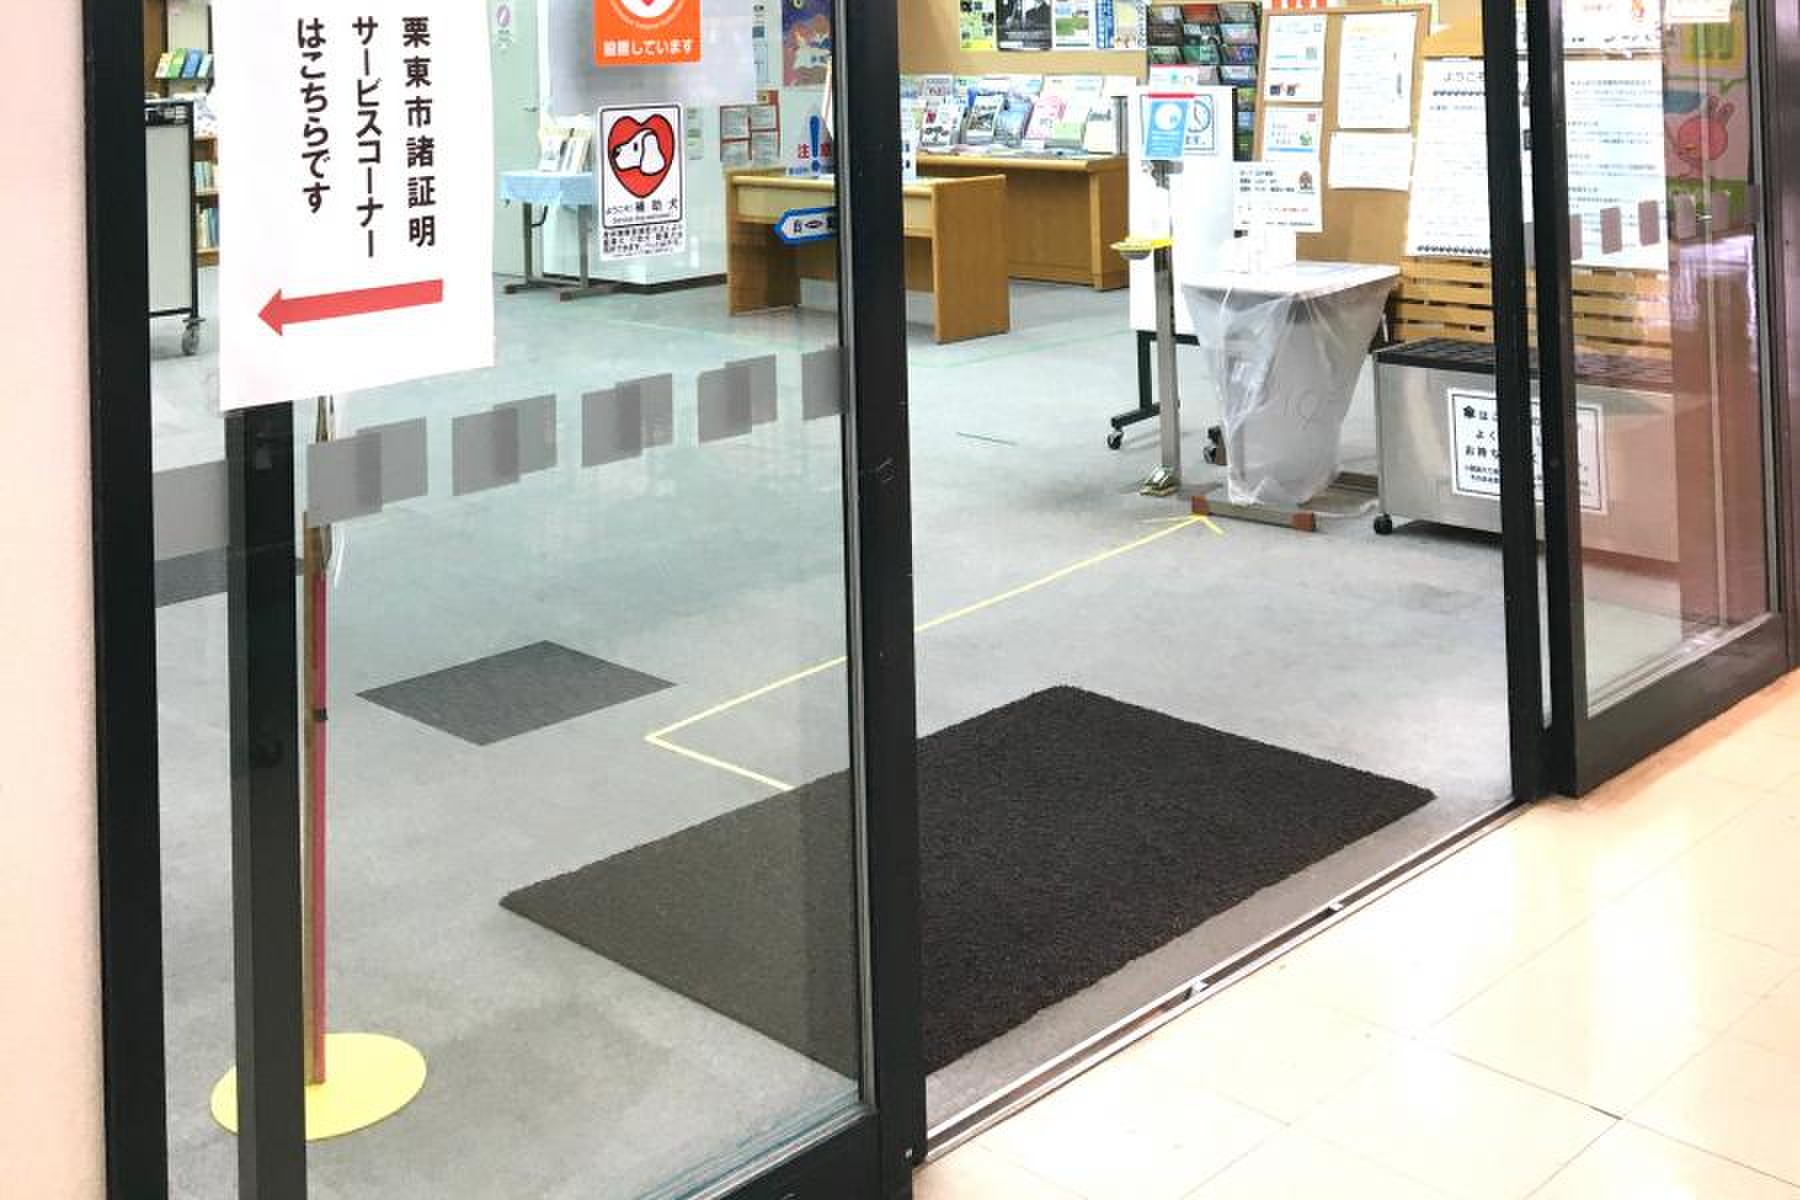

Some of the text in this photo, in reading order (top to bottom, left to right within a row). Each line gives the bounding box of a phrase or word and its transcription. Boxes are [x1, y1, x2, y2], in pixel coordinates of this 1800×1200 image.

[297, 17, 331, 214] はこちらです
[351, 15, 385, 258] サービスコーナー
[402, 16, 436, 248] 栗東市諸証明
